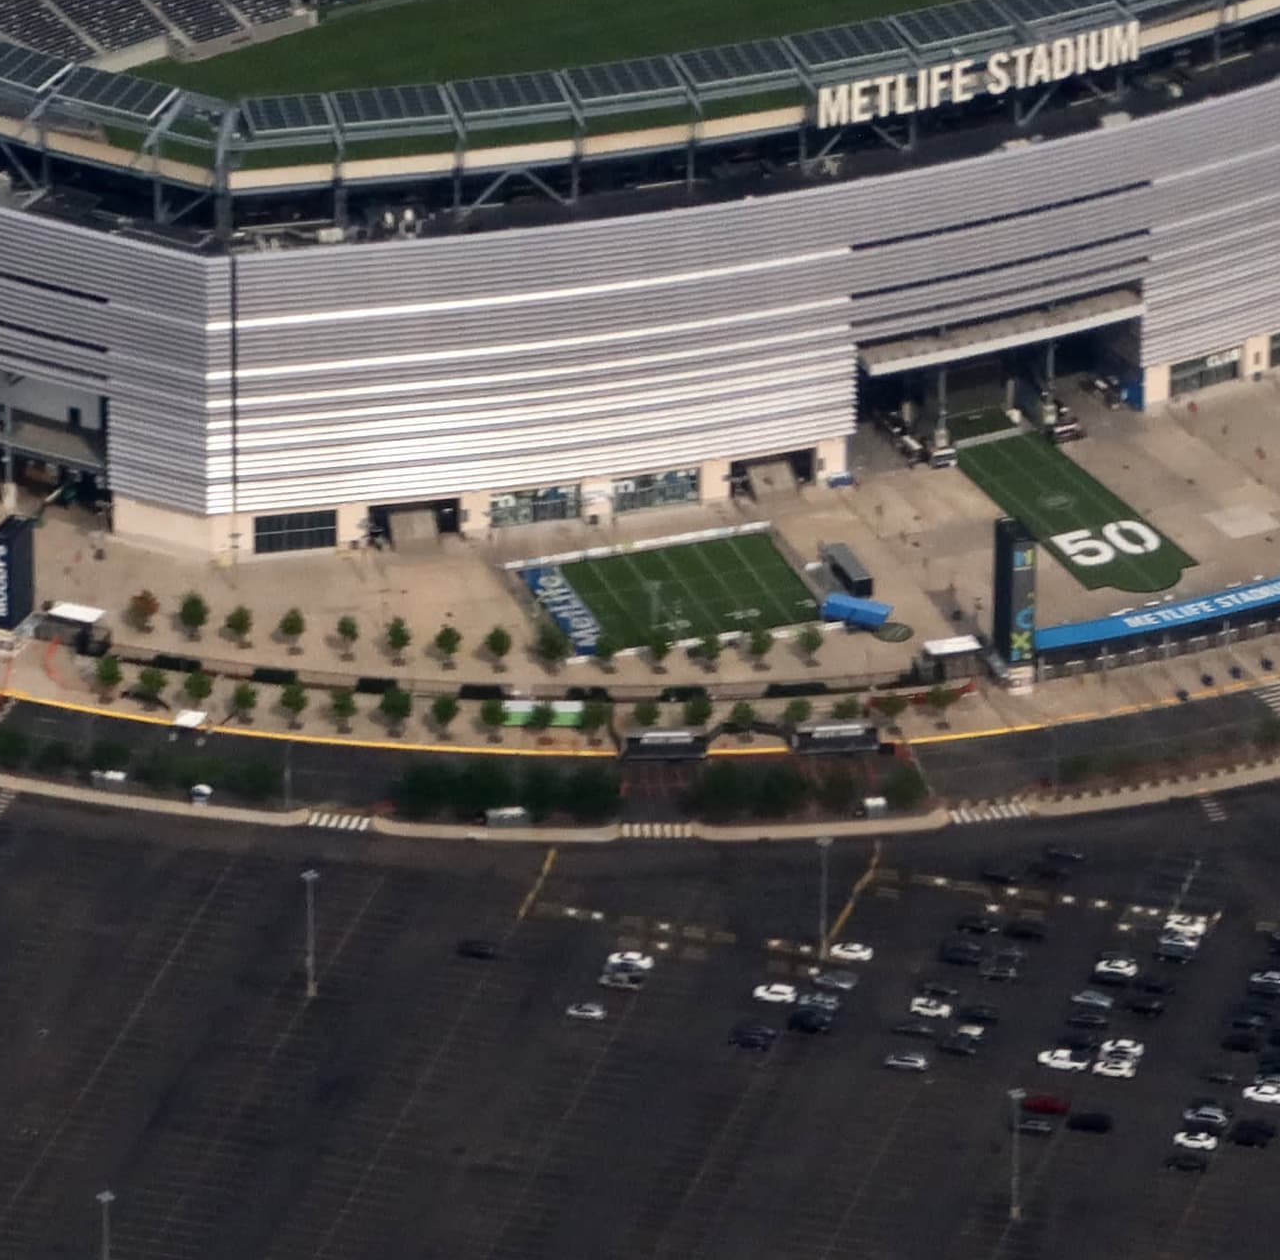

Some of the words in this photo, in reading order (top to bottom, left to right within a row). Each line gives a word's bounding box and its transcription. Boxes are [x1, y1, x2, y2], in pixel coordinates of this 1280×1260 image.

[817, 59, 976, 129] METLIFE
[986, 20, 1140, 95] STADIUM
[1049, 519, 1162, 568] 50
[1123, 600, 1216, 628] METLIFE
